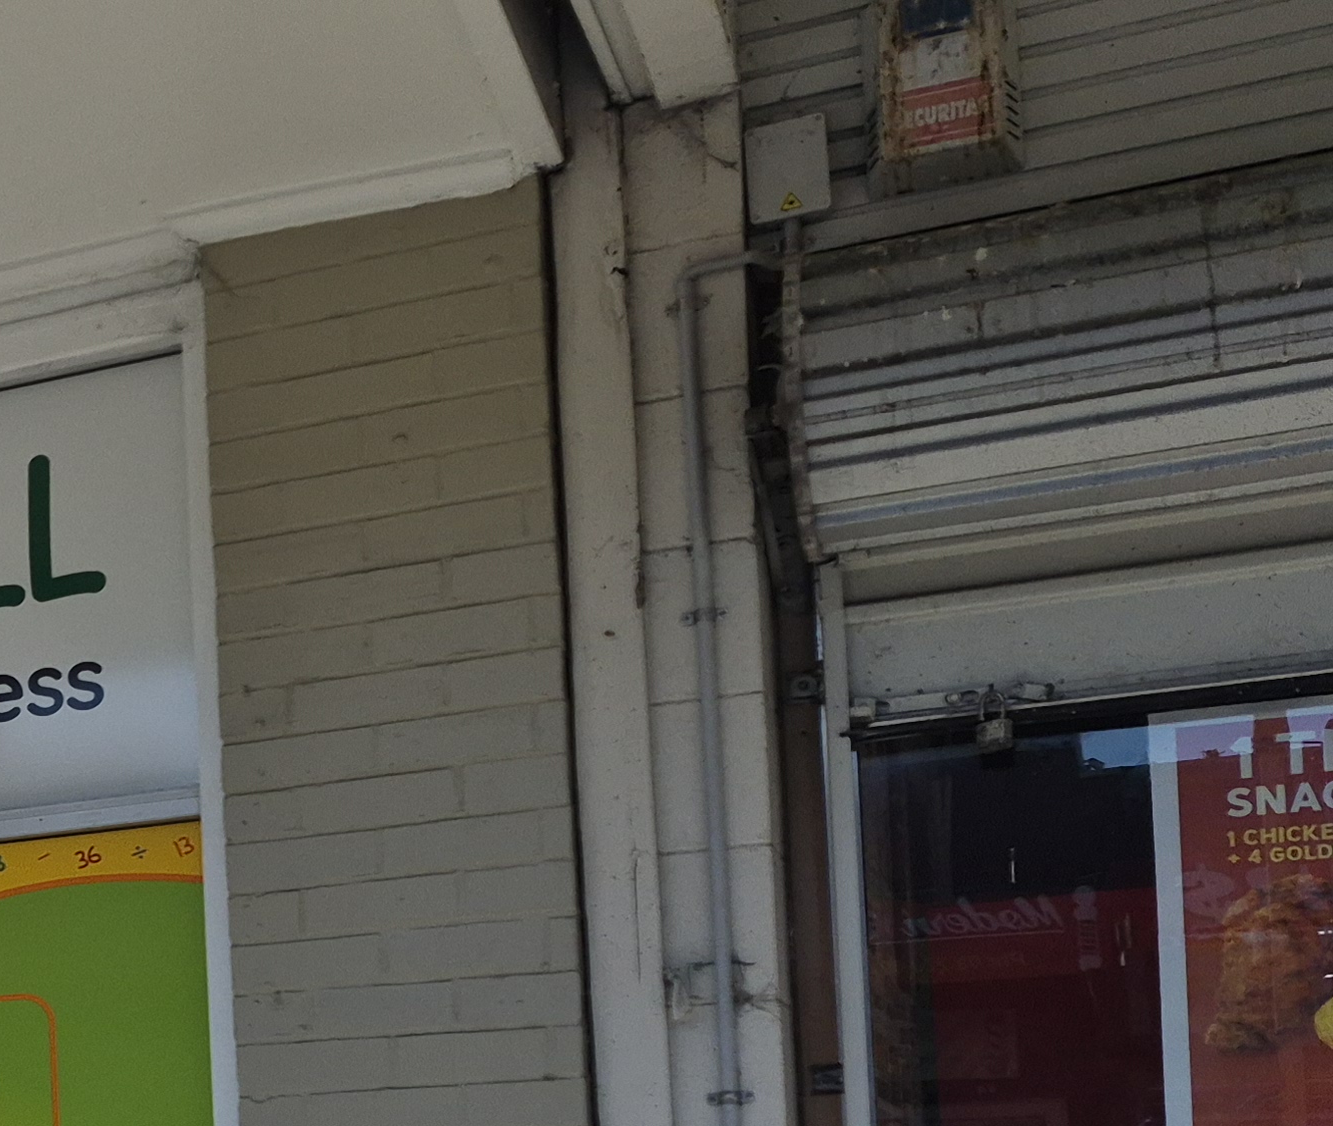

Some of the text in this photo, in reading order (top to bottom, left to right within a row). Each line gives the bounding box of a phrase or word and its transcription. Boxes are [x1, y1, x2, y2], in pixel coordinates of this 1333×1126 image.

[900, 96, 989, 130] ECURITA
[1226, 831, 1236, 847] 1
[74, 846, 102, 869] 36
[174, 836, 194, 857] 13
[1248, 849, 1262, 864] 4
